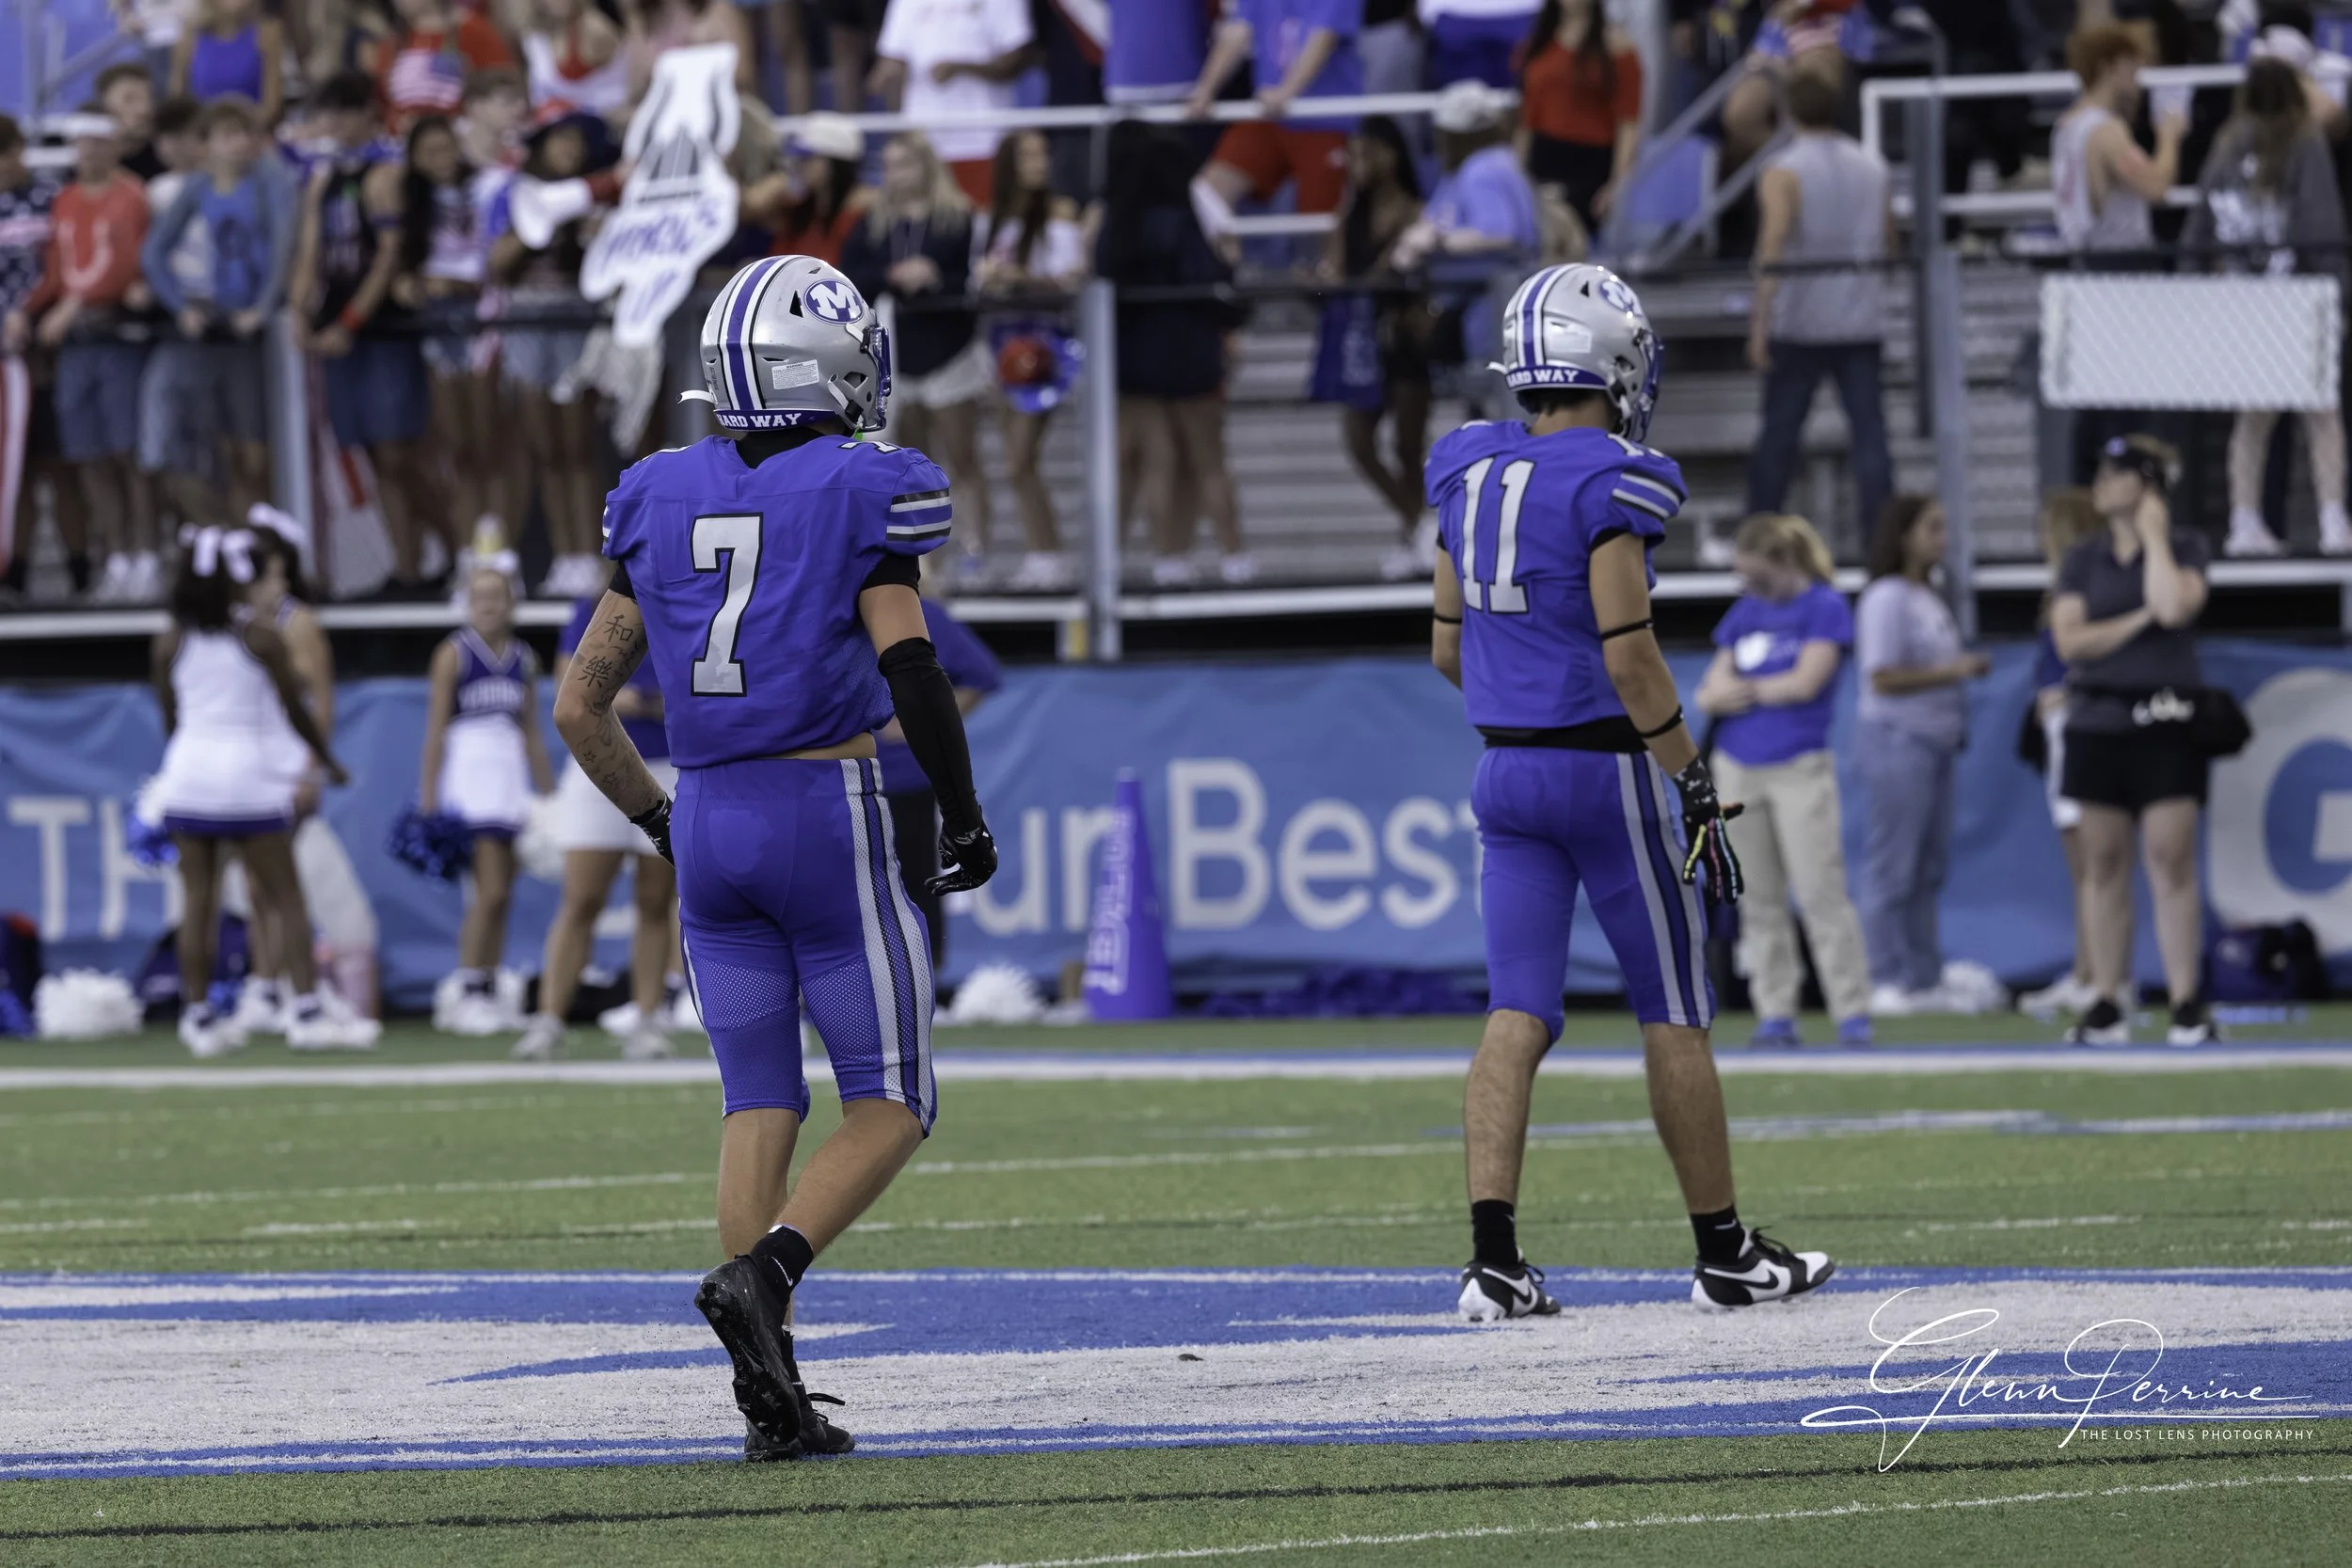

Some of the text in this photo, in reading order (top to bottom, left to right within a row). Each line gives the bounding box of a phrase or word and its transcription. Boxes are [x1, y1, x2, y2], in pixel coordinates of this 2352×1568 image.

[808, 281, 863, 321] M
[750, 413, 802, 427] WAY
[1533, 369, 1579, 383] WAY
[1462, 455, 1535, 613] 11
[690, 512, 763, 697] 7
[941, 805, 1121, 936] ur
[1168, 757, 1482, 931] Bes
